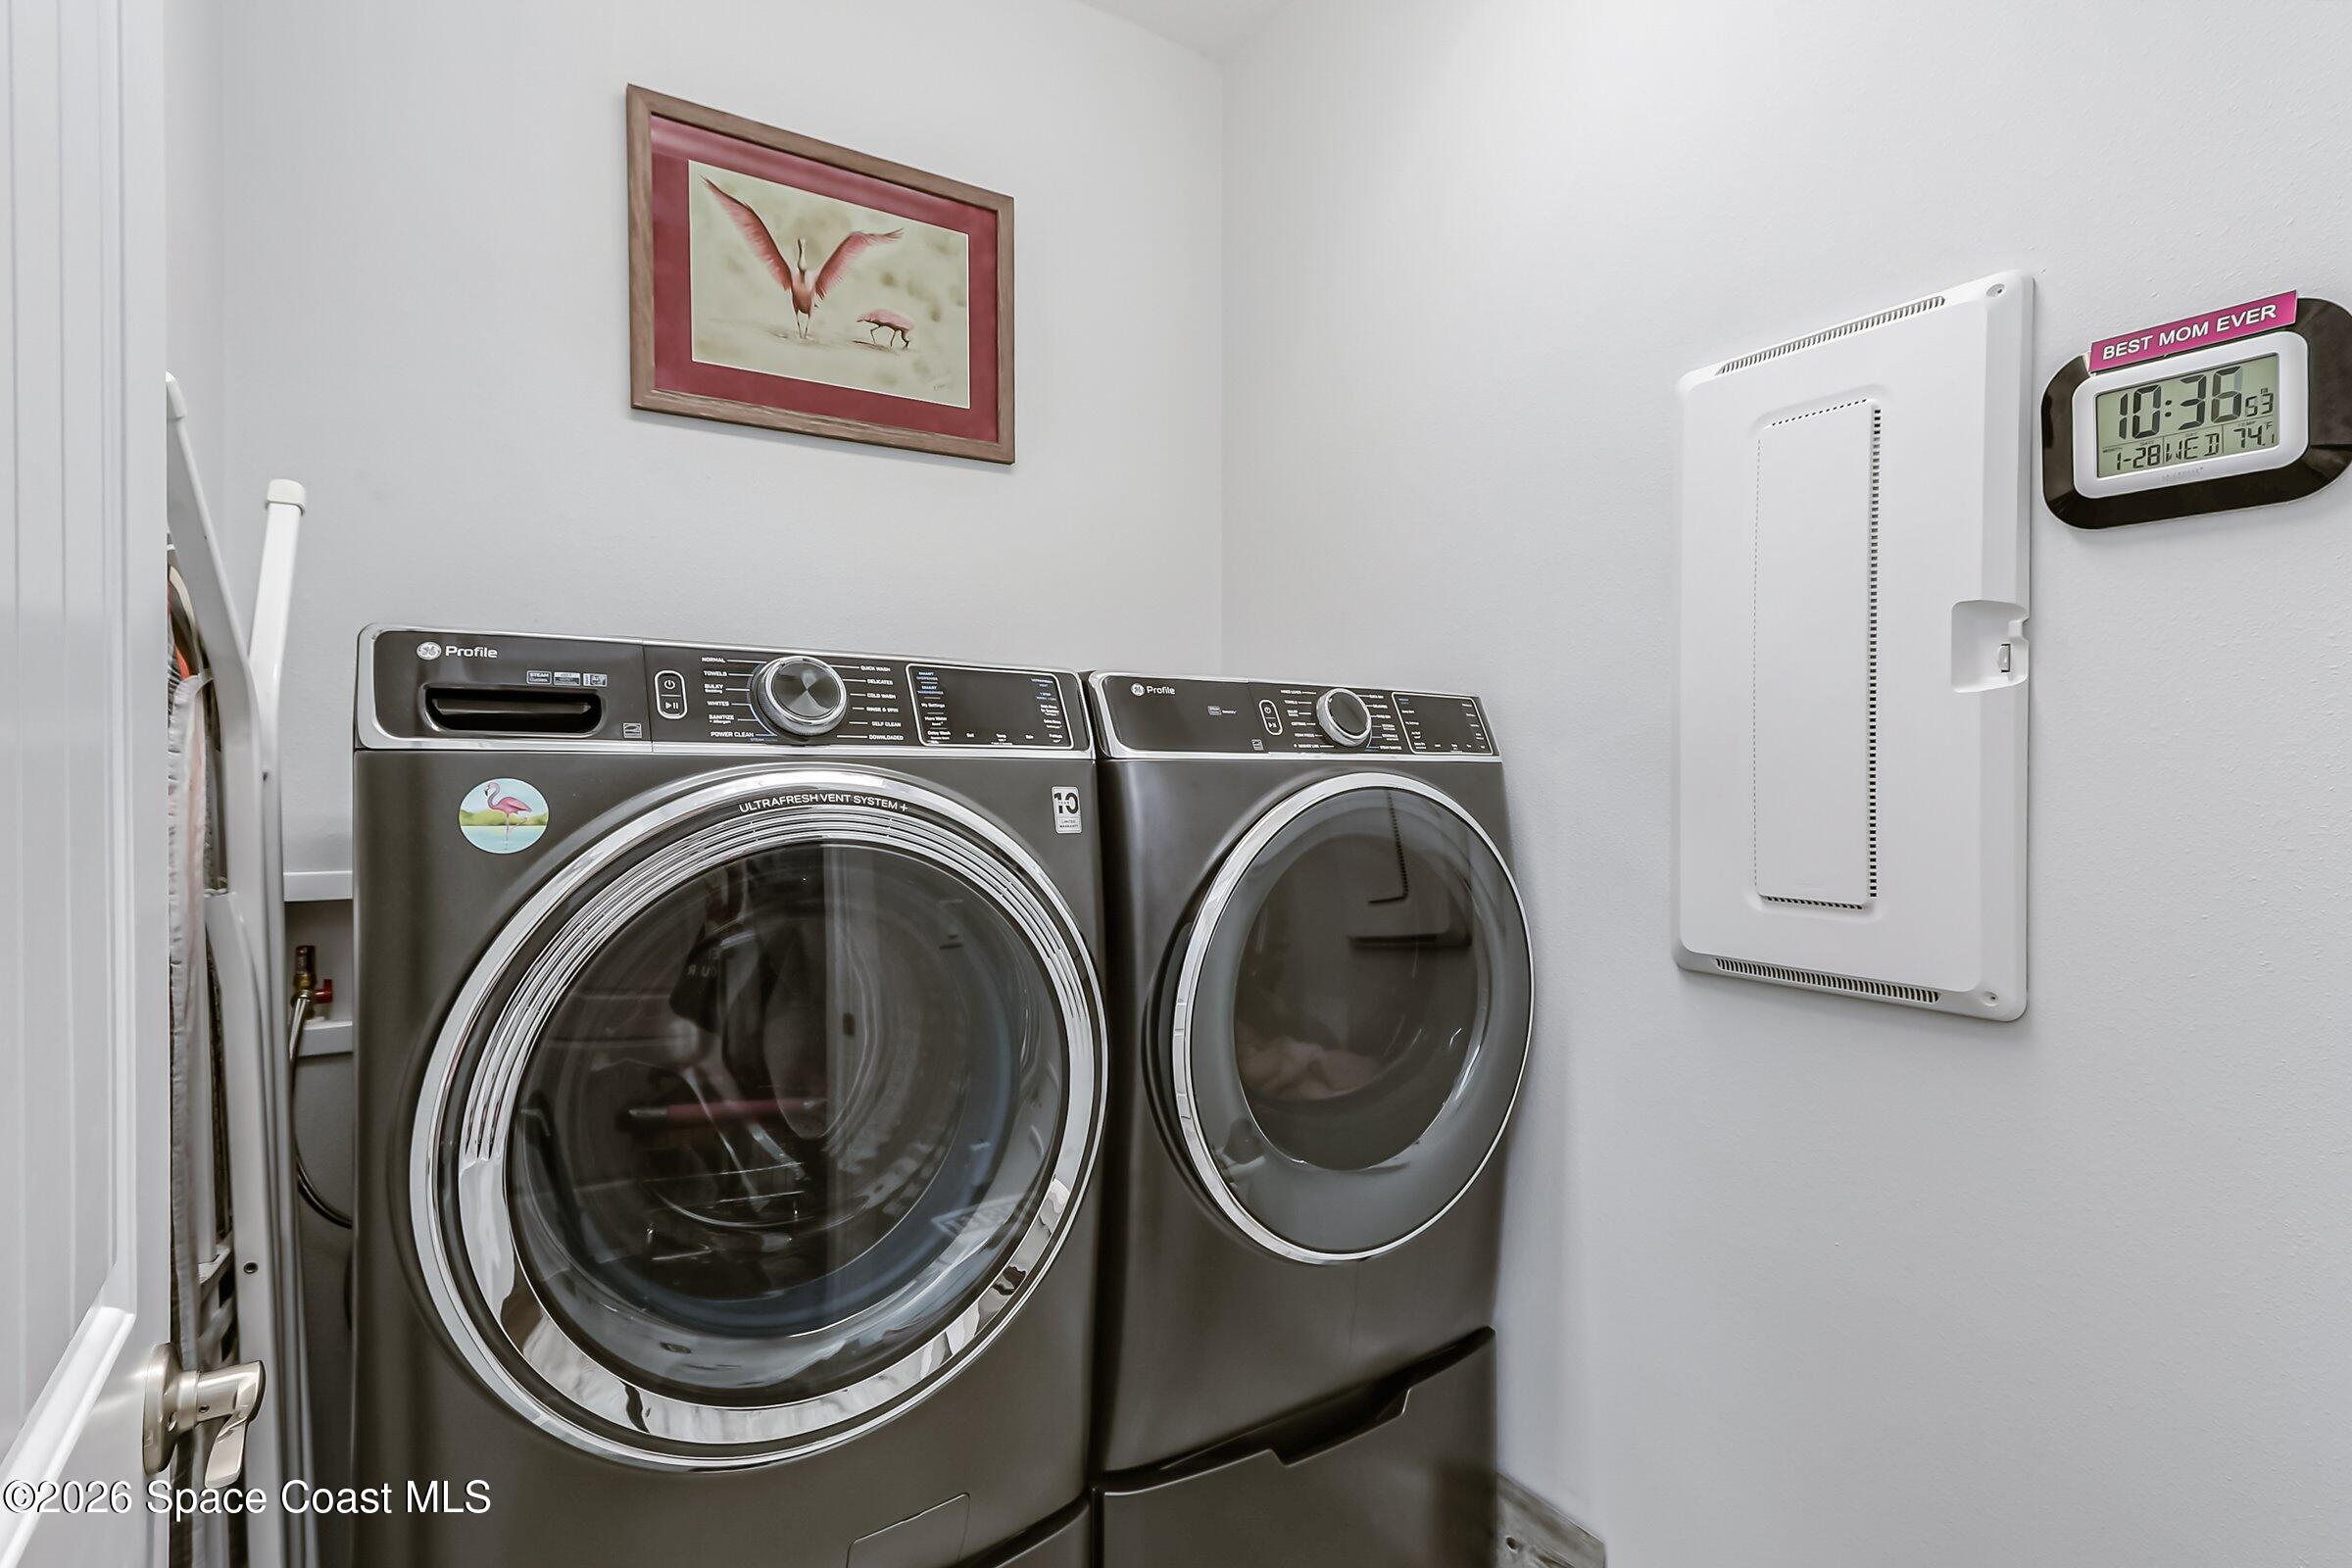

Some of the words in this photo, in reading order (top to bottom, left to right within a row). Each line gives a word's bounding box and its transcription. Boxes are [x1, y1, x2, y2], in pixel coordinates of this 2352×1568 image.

[2102, 335, 2153, 361] BEST
[2158, 321, 2209, 347] MOM
[2216, 304, 2277, 331] EVER
[2119, 366, 2242, 439] 10:36
[2245, 393, 2274, 417] 53
[2117, 444, 2161, 470] 1-28
[2165, 433, 2220, 465] WED
[445, 645, 498, 659] Profile
[1146, 686, 1176, 695] Profile
[739, 794, 818, 813] ULTRAFRESH
[819, 793, 851, 803] VENT
[853, 795, 899, 810] SYSTEM
[1054, 792, 1079, 814] 10
